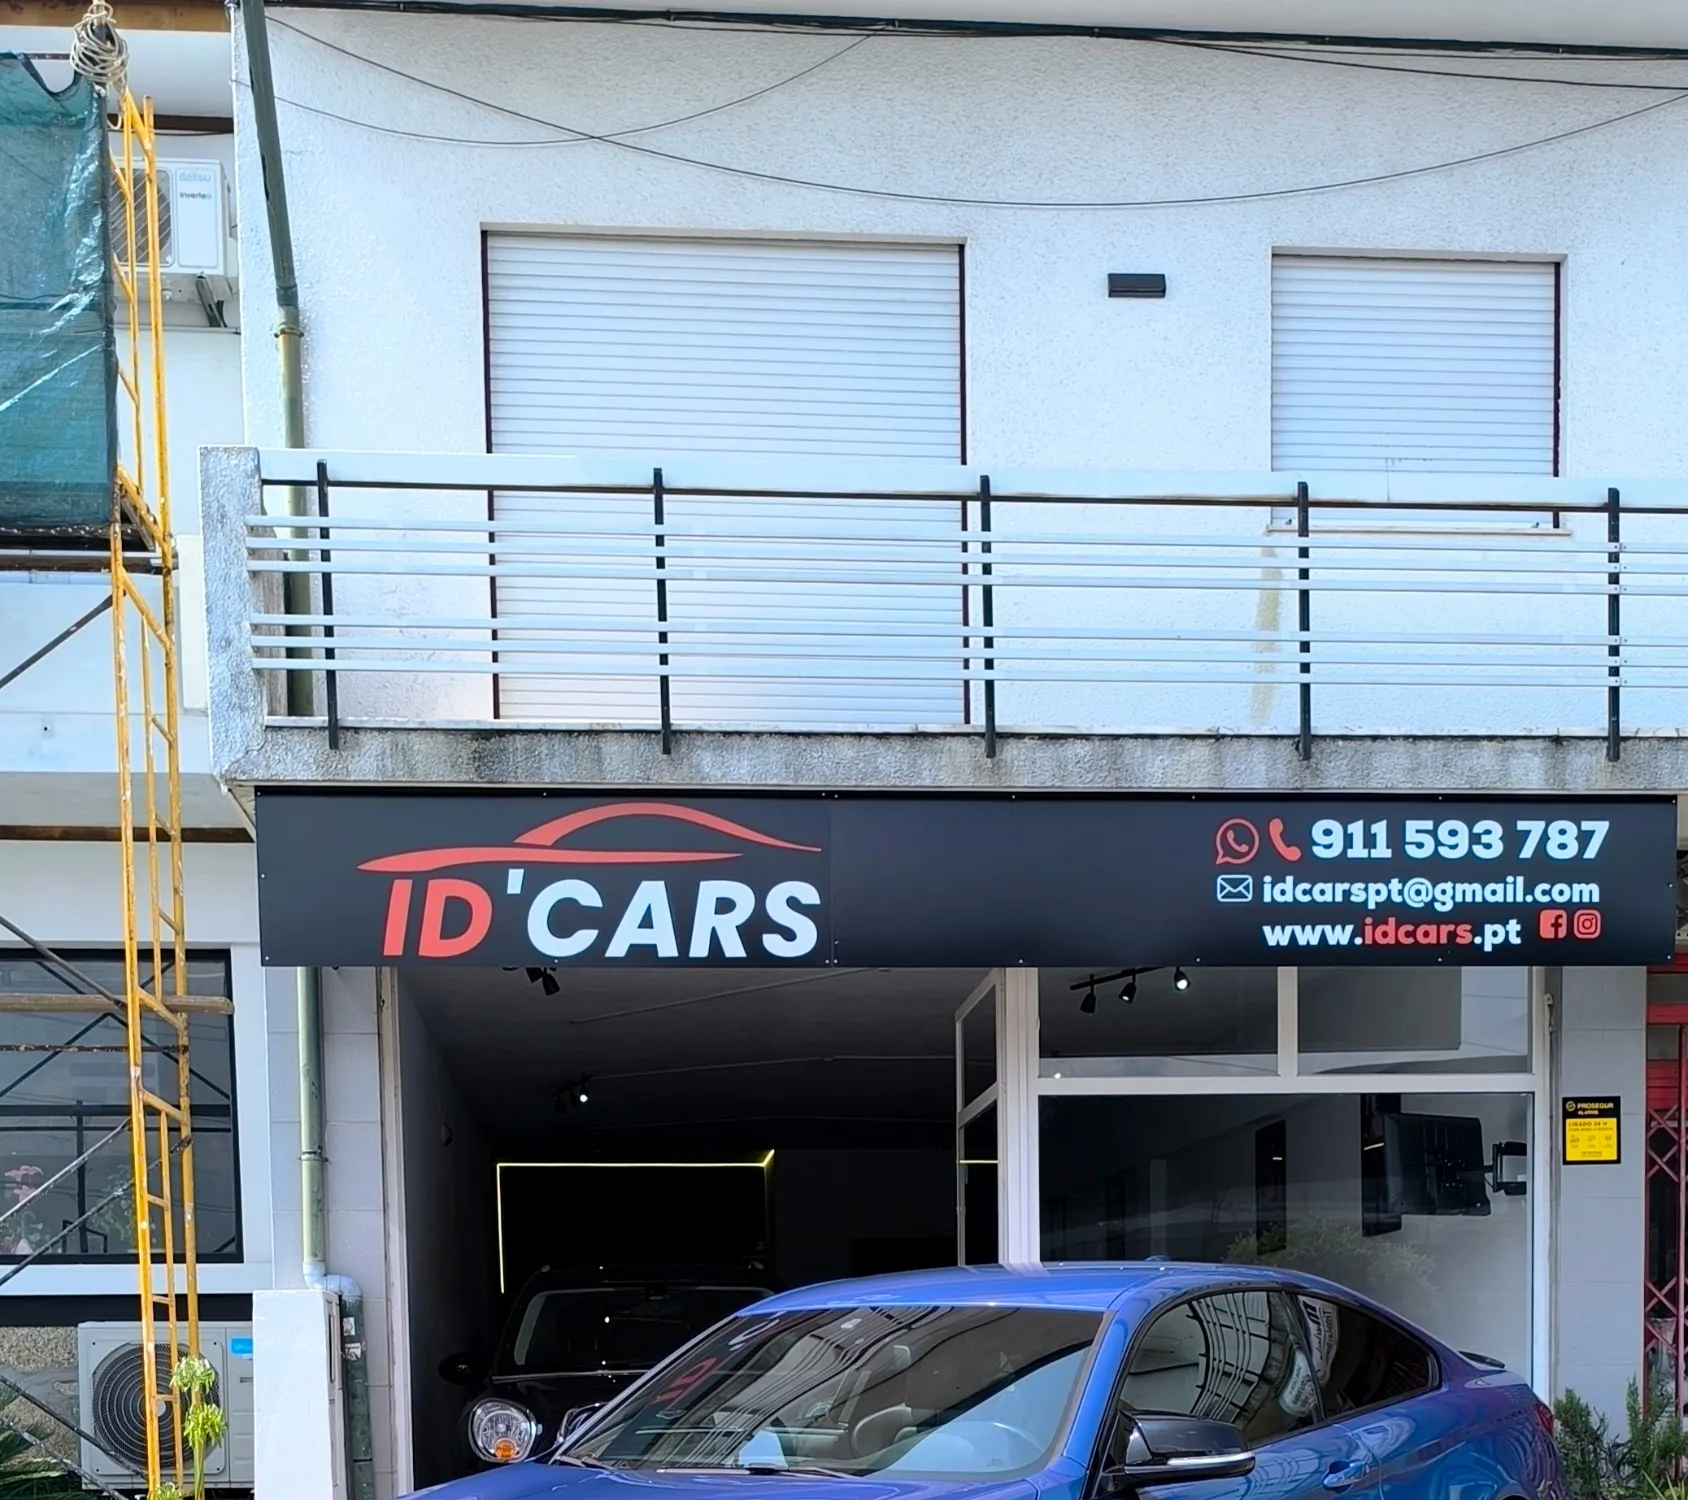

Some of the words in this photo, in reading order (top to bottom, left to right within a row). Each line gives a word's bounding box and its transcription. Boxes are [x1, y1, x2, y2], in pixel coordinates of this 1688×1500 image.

[1311, 818, 1392, 859] 911
[1404, 819, 1504, 860] 593
[1516, 820, 1610, 860] 787
[383, 868, 821, 958] ID'CARS
[1262, 875, 1600, 912] idcarspt@gmail.com
[1262, 917, 1522, 952] www.idcars.pt
